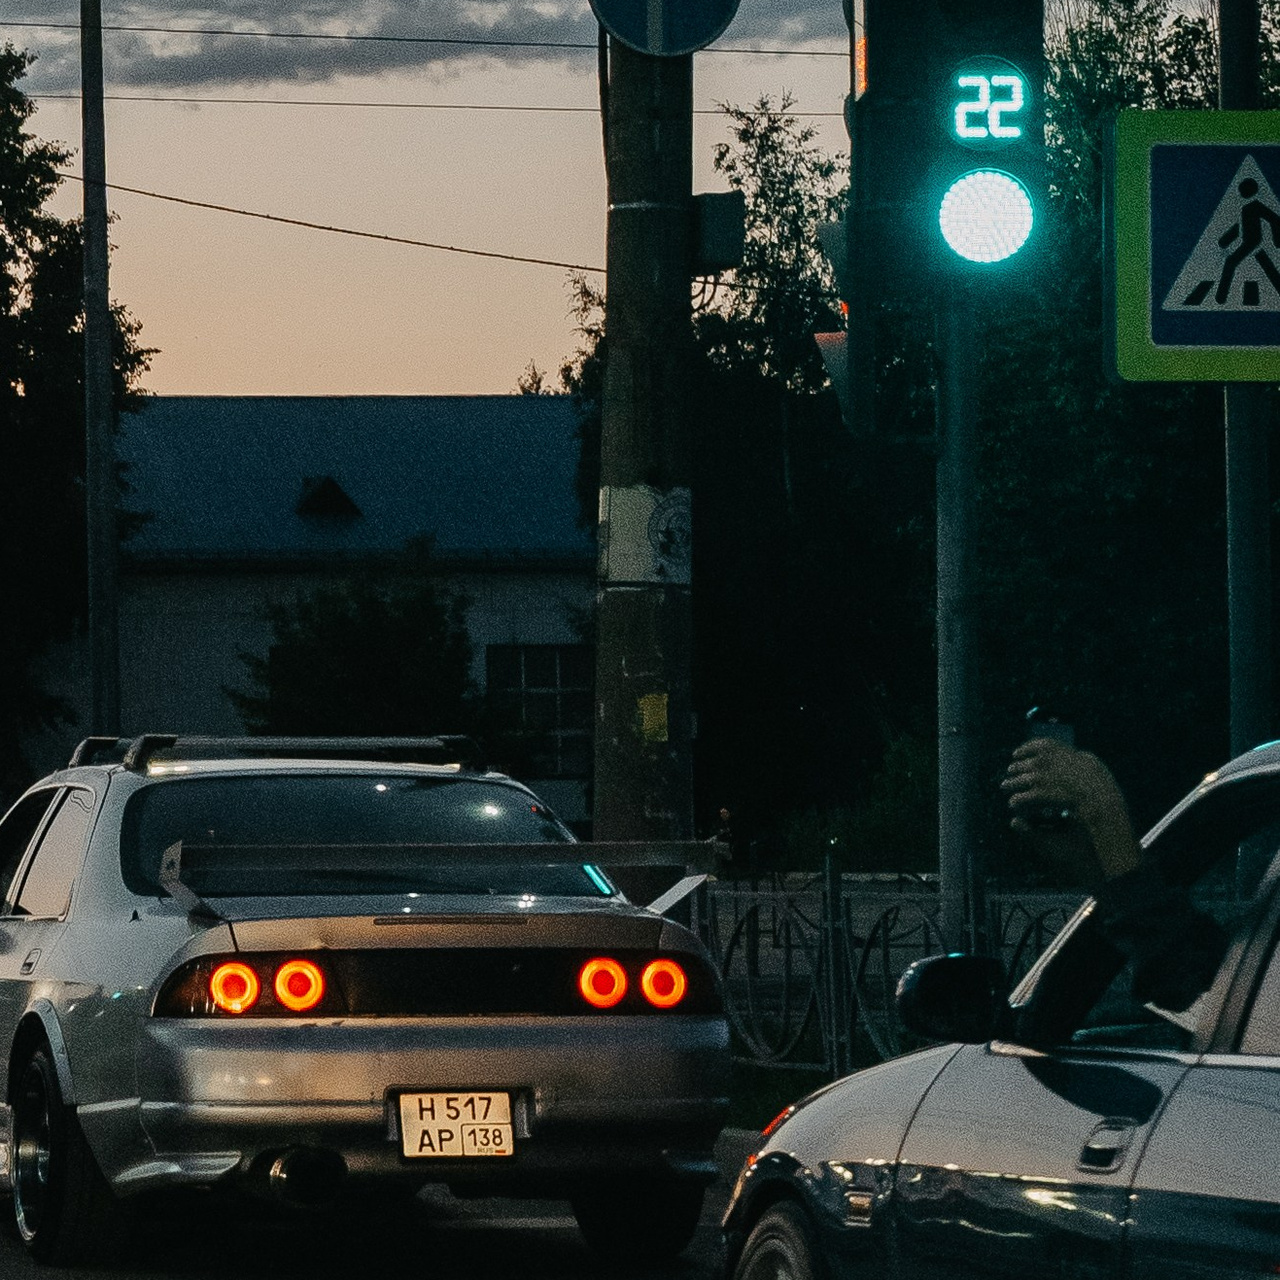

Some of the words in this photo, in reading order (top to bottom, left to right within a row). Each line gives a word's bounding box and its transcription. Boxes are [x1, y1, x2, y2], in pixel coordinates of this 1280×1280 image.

[955, 76, 1023, 138] 22
[418, 1098, 435, 1120] Н
[446, 1097, 492, 1120] 517
[418, 1129, 455, 1152] АР
[467, 1128, 503, 1147] 138
